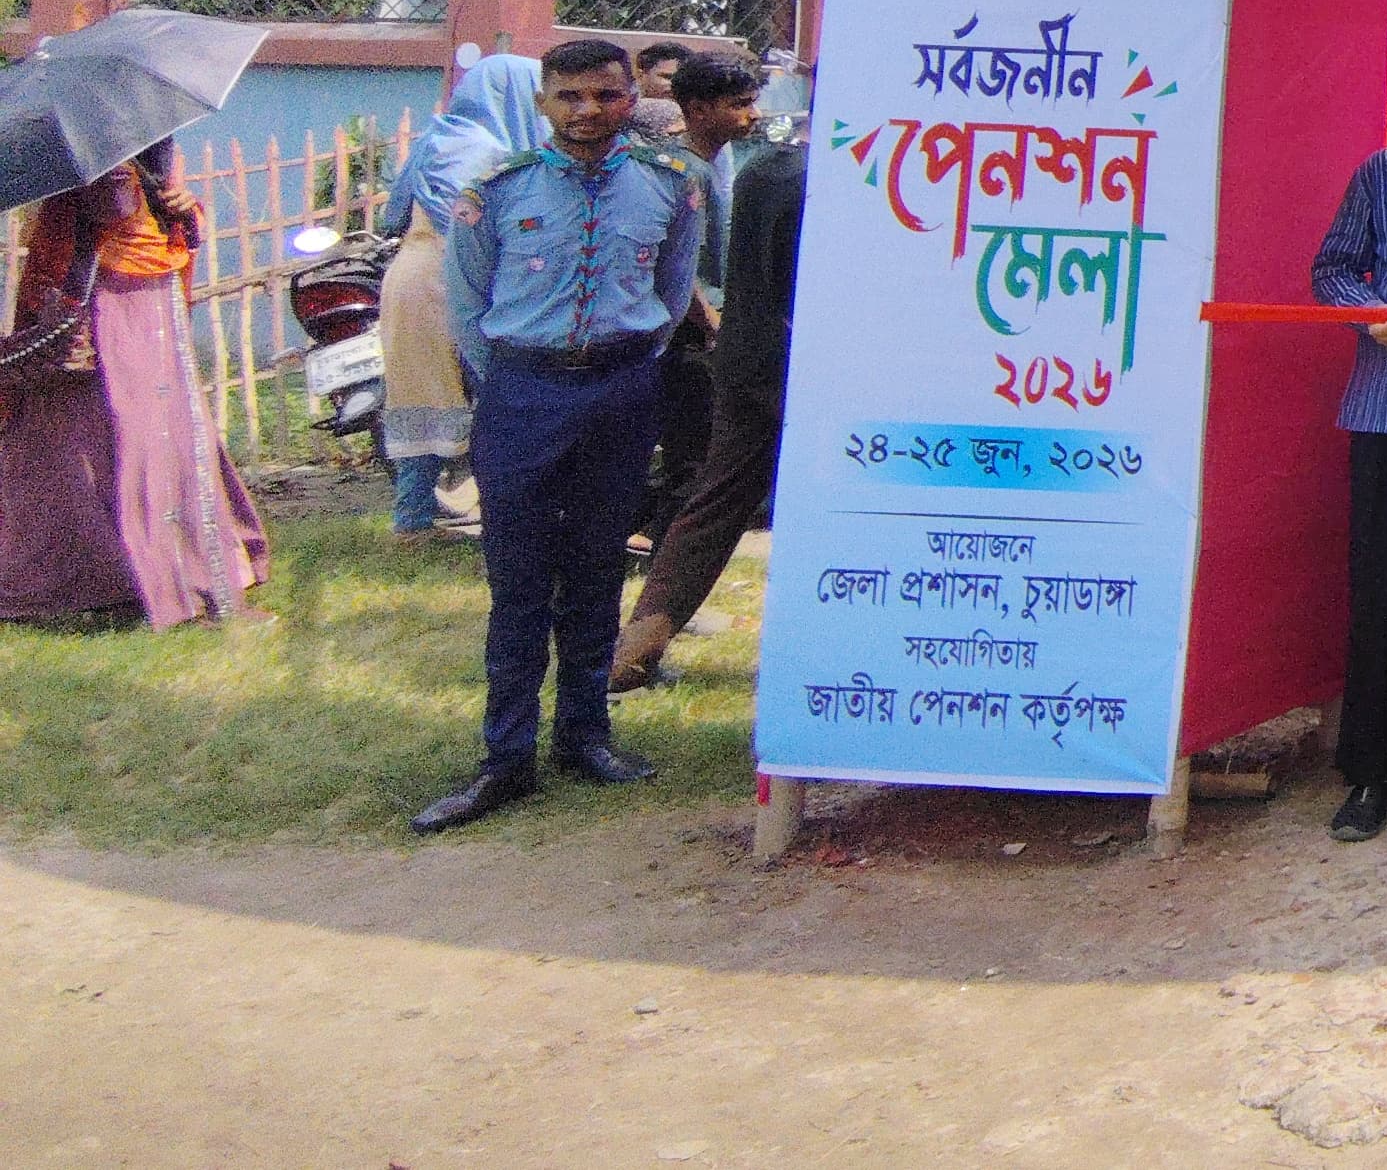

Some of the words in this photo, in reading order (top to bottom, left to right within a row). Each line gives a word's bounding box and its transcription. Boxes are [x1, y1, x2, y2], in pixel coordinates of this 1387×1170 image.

[912, 10, 1104, 111] সর্বজনীন
[885, 118, 1158, 270] পেনশন
[971, 222, 1168, 384] মেলা
[993, 352, 1113, 413] ২০২৬
[845, 433, 957, 469] ২৪-২৫
[968, 437, 1032, 478] জুন,
[1048, 441, 1143, 479] ২০২৬
[926, 528, 1036, 563] আয়োজনে
[816, 566, 891, 605] জেলা
[899, 567, 1009, 620] প্রশাসন,
[1021, 574, 1137, 623] চুয়াডাঙ্গা
[904, 629, 1039, 669] সহযোগিতায়
[804, 672, 898, 726] জাতীয়
[909, 689, 1012, 730] পেনশন
[1019, 682, 1128, 749] কর্তৃপক্ষ
